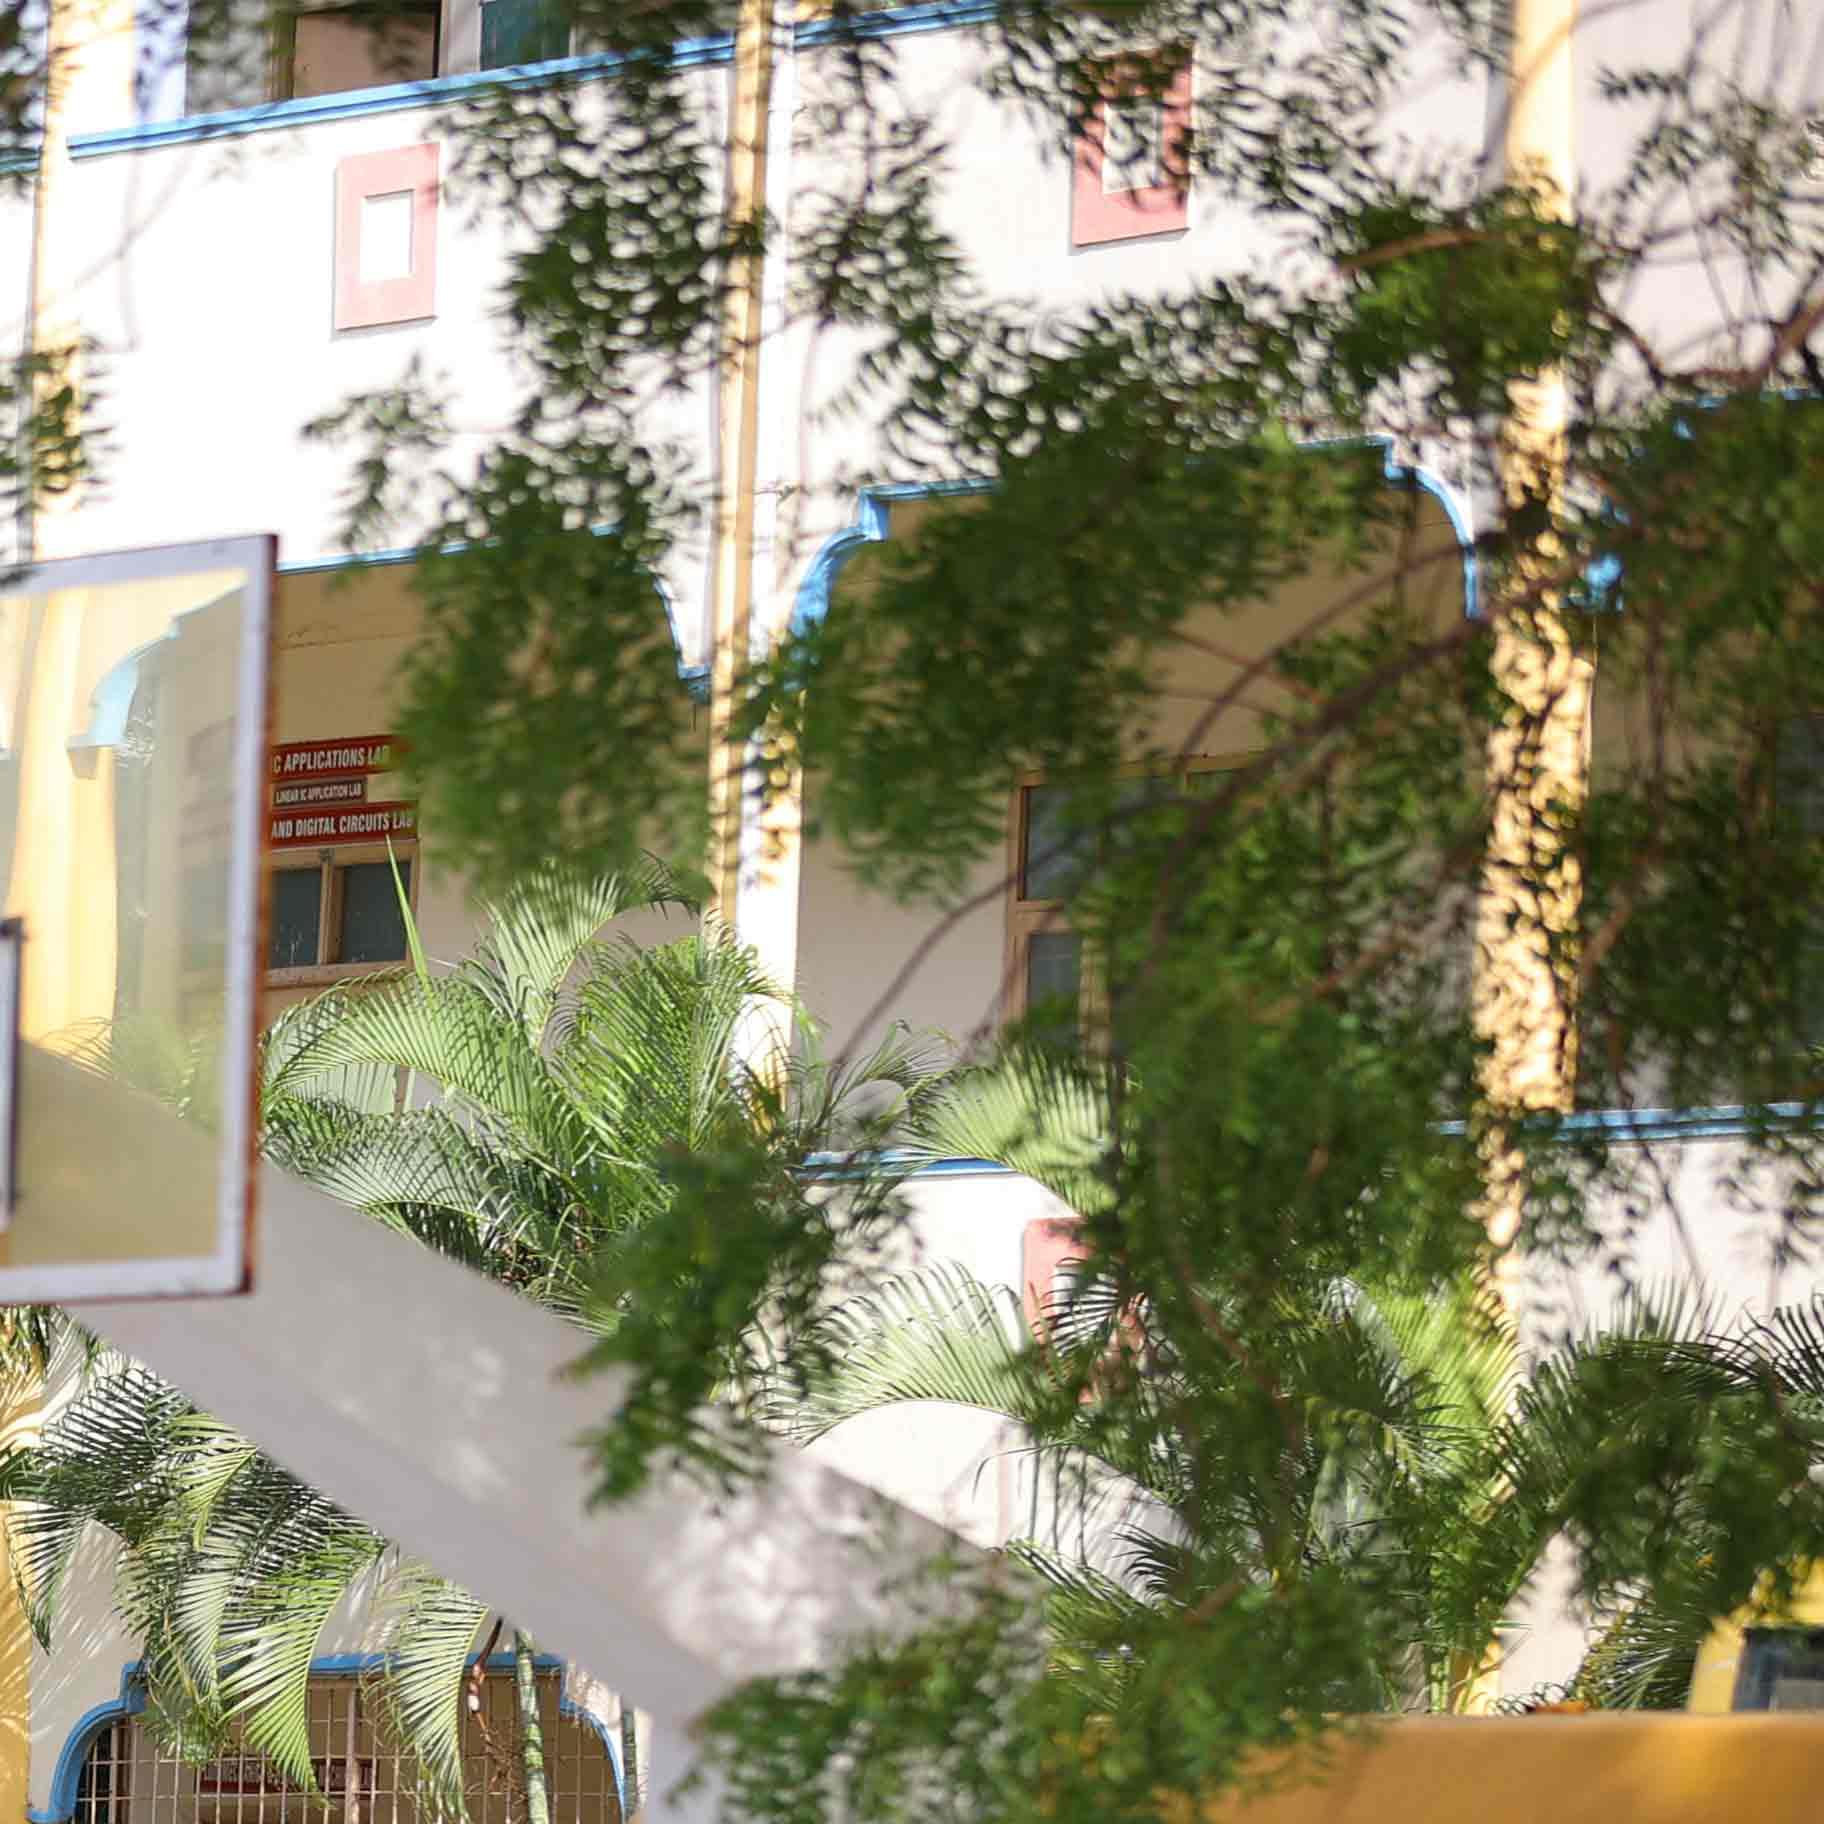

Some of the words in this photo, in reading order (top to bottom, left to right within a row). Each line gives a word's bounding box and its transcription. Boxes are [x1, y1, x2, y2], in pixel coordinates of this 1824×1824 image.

[283, 747, 365, 773] APPLICATIONS
[272, 820, 294, 839] AND
[295, 815, 337, 837] DIGITAL
[339, 811, 390, 834] CIRCUITS
